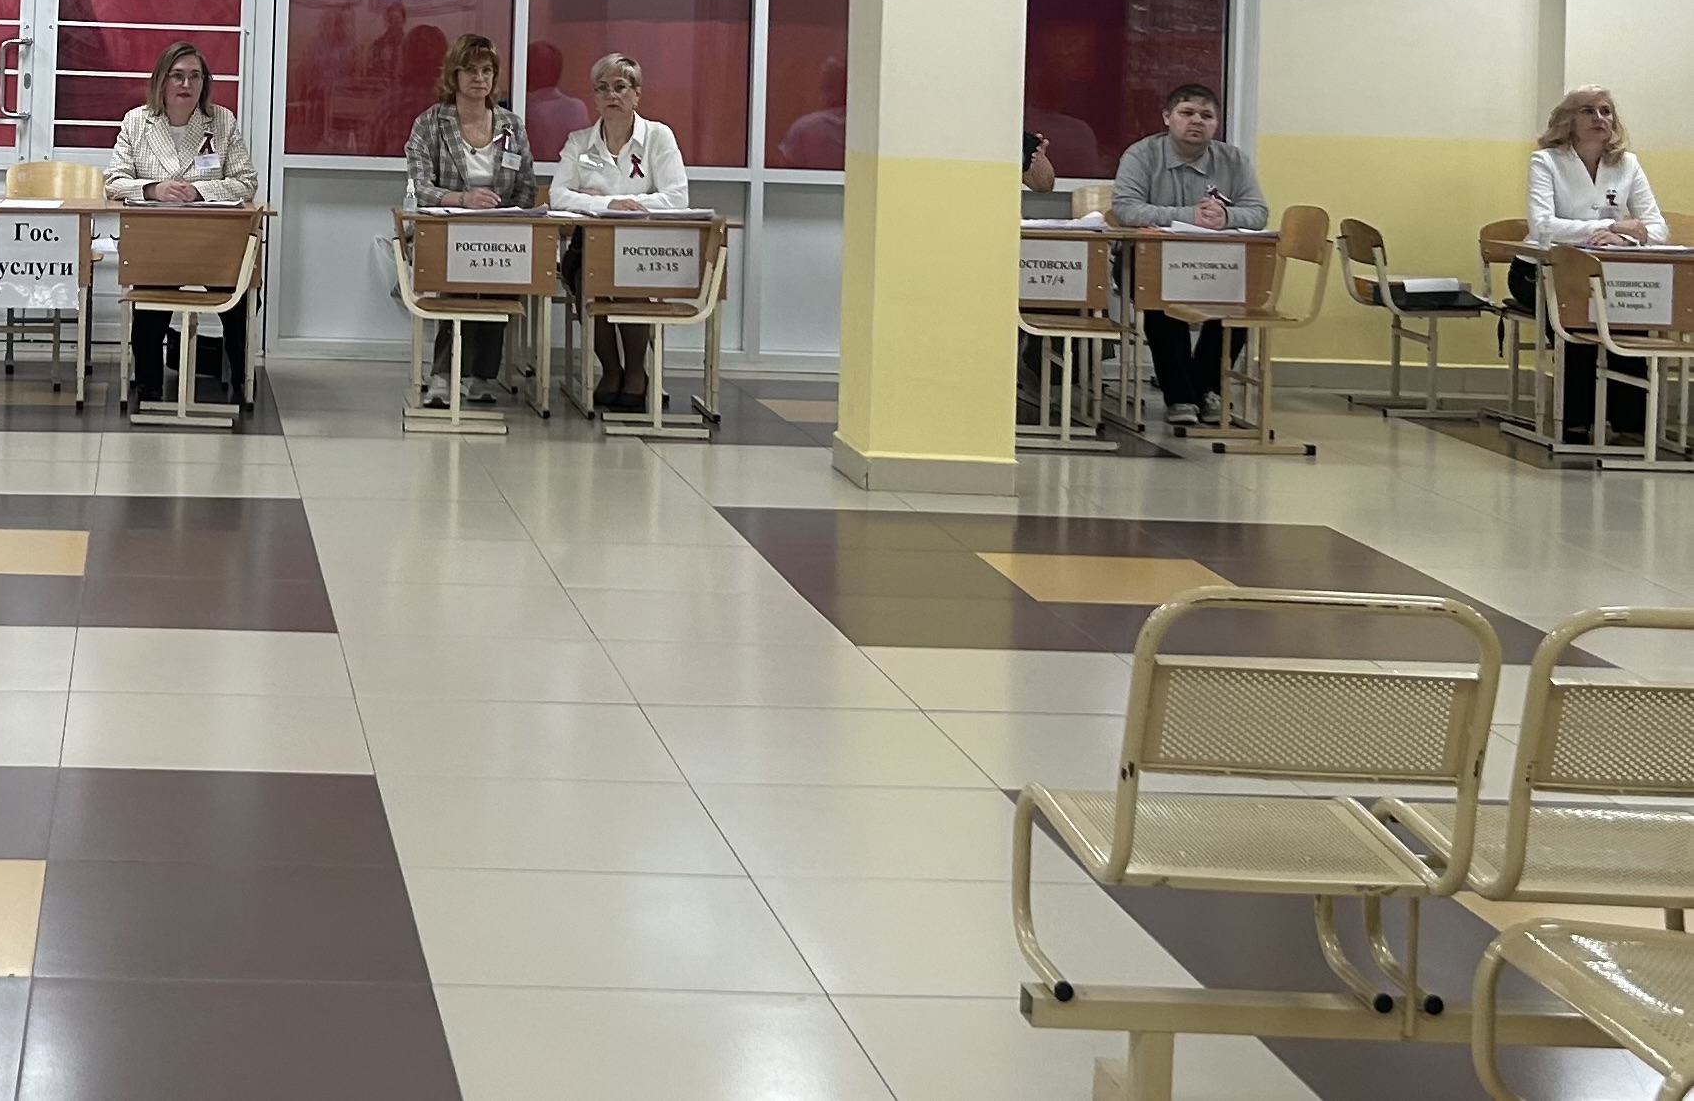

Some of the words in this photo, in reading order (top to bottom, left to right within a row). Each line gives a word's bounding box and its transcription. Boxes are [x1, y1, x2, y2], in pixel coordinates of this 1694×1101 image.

[14, 222, 59, 242] Гос.
[455, 242, 527, 254] РОСТОВСКАЯ
[622, 246, 694, 258] РОСТОВСКАЯ
[481, 257, 512, 268] 13-15
[649, 262, 680, 272] 13-15
[1018, 259, 1082, 270] ОСТОВСКАЯ
[1041, 275, 1065, 285] 17/4
[1607, 280, 1661, 289] ОЛПИНСКОЕ
